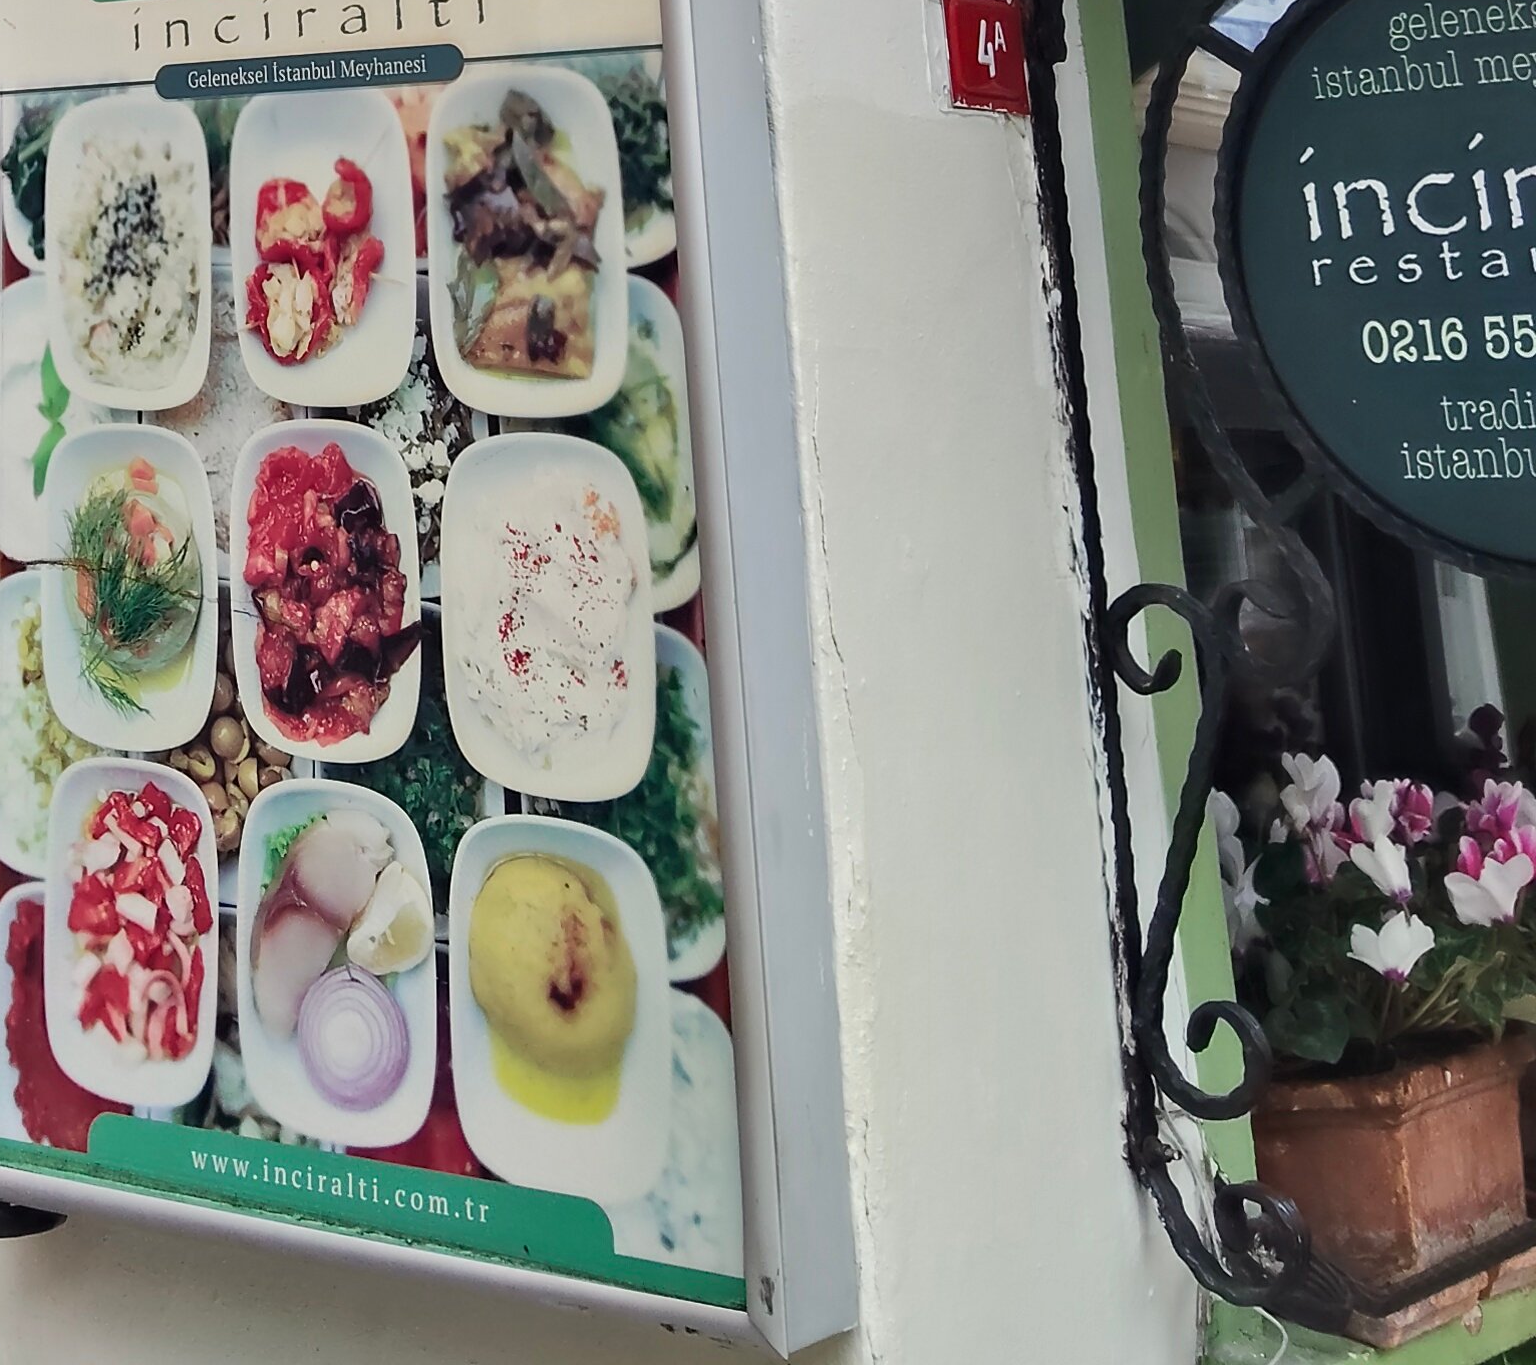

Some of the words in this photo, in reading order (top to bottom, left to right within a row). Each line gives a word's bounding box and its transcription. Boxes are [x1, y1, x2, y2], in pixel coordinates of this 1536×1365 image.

[187, 63, 269, 89] Geleneksel
[272, 55, 337, 84] İstanbul
[340, 54, 427, 83] Meyhanesi
[1311, 50, 1464, 100] istanbul
[1474, 52, 1536, 88] me
[1312, 240, 1536, 287] resta
[1362, 316, 1468, 364] 0216
[1483, 314, 1536, 360] 55
[1440, 388, 1536, 431] tradi
[190, 1150, 490, 1223] www.inciralti.com.tr
